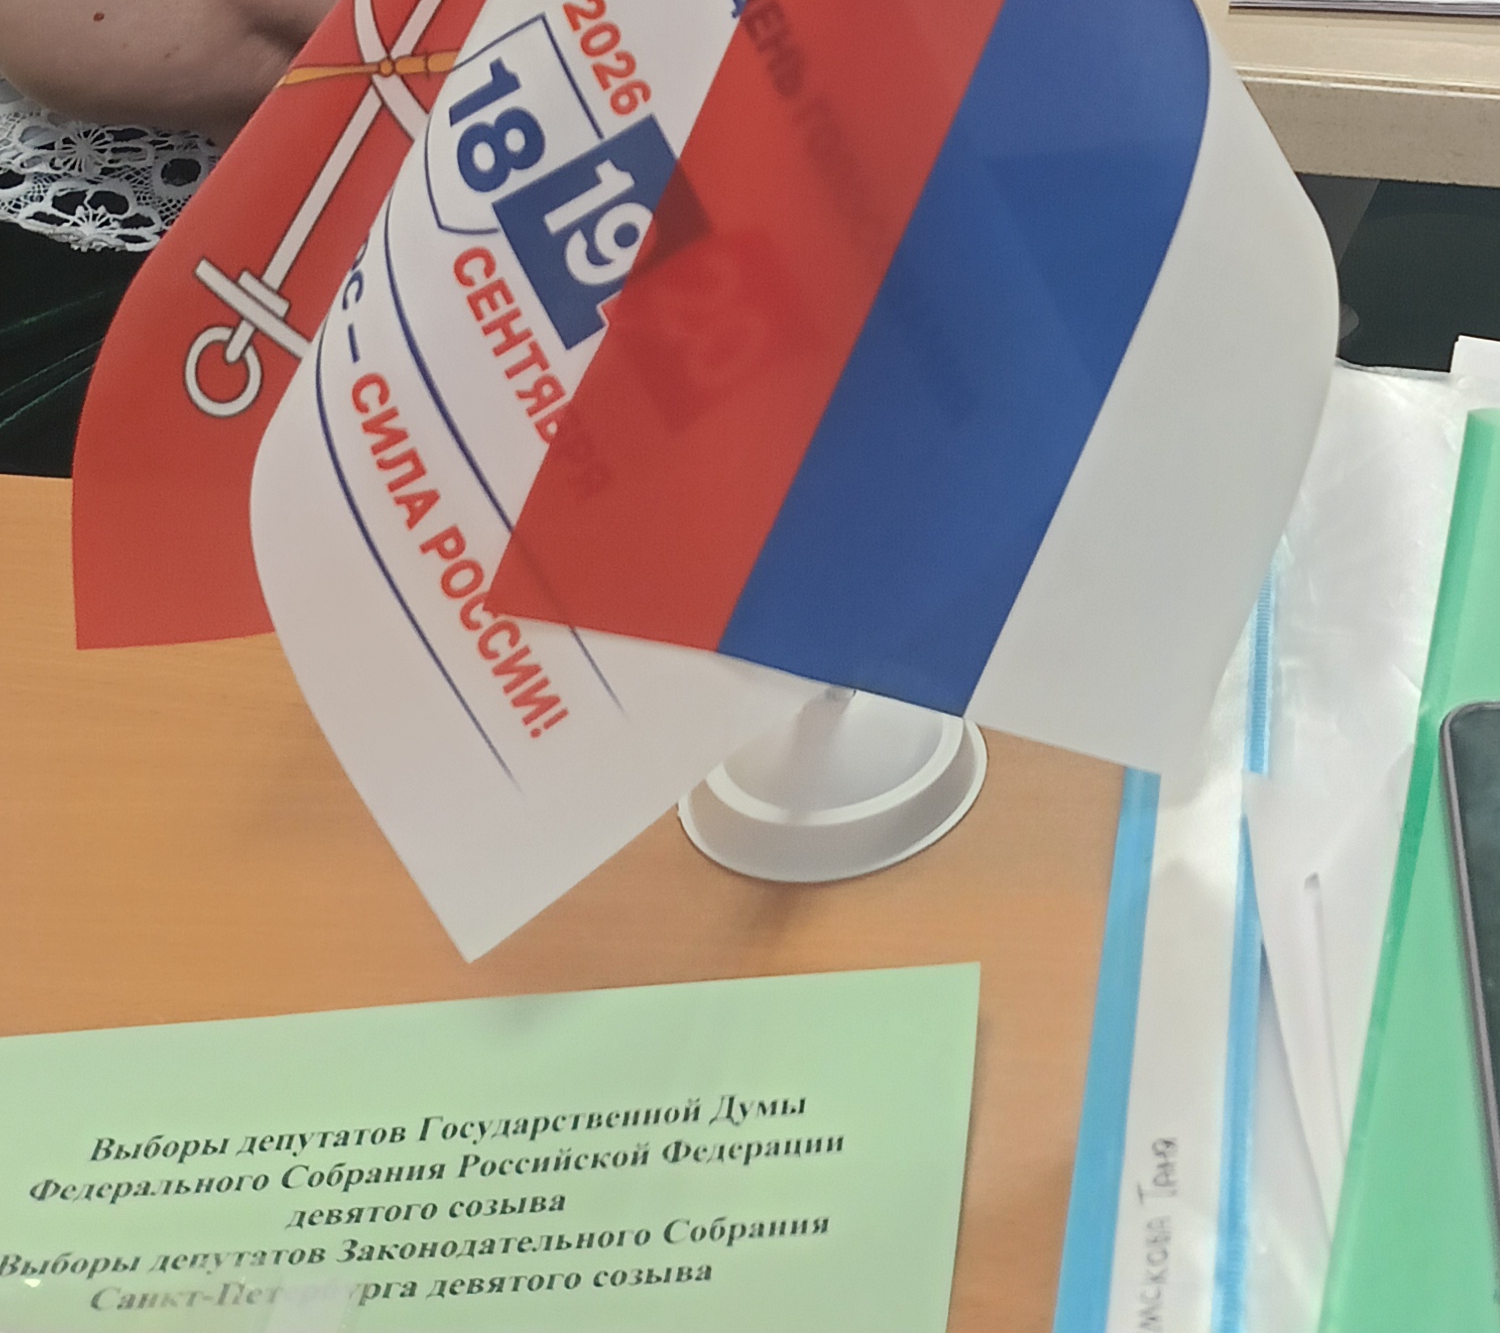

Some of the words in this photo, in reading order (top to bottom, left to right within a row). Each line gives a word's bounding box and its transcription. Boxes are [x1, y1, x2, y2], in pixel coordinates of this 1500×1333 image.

[447, 58, 546, 195] 18
[543, 160, 655, 290] 19
[350, 370, 441, 532] СИЛА
[421, 525, 570, 739] РОССИИ!
[90, 1134, 230, 1165] Выборы
[236, 1123, 407, 1158] депутатов
[418, 1097, 702, 1145] Государственной
[709, 1093, 807, 1128] Думы
[29, 1172, 270, 1205] Федерального
[281, 1162, 446, 1194] Собрания
[458, 1141, 651, 1180] Российской
[662, 1133, 845, 1167] Федерации
[0, 1251, 142, 1280] Выборы
[149, 1244, 327, 1277] депутатов
[336, 1227, 652, 1264] Законодательного
[663, 1214, 830, 1249] Собрания
[284, 1201, 439, 1231] девятого
[448, 1192, 567, 1219] созыва
[427, 1270, 582, 1300] девятого
[593, 1261, 713, 1289] созыва
